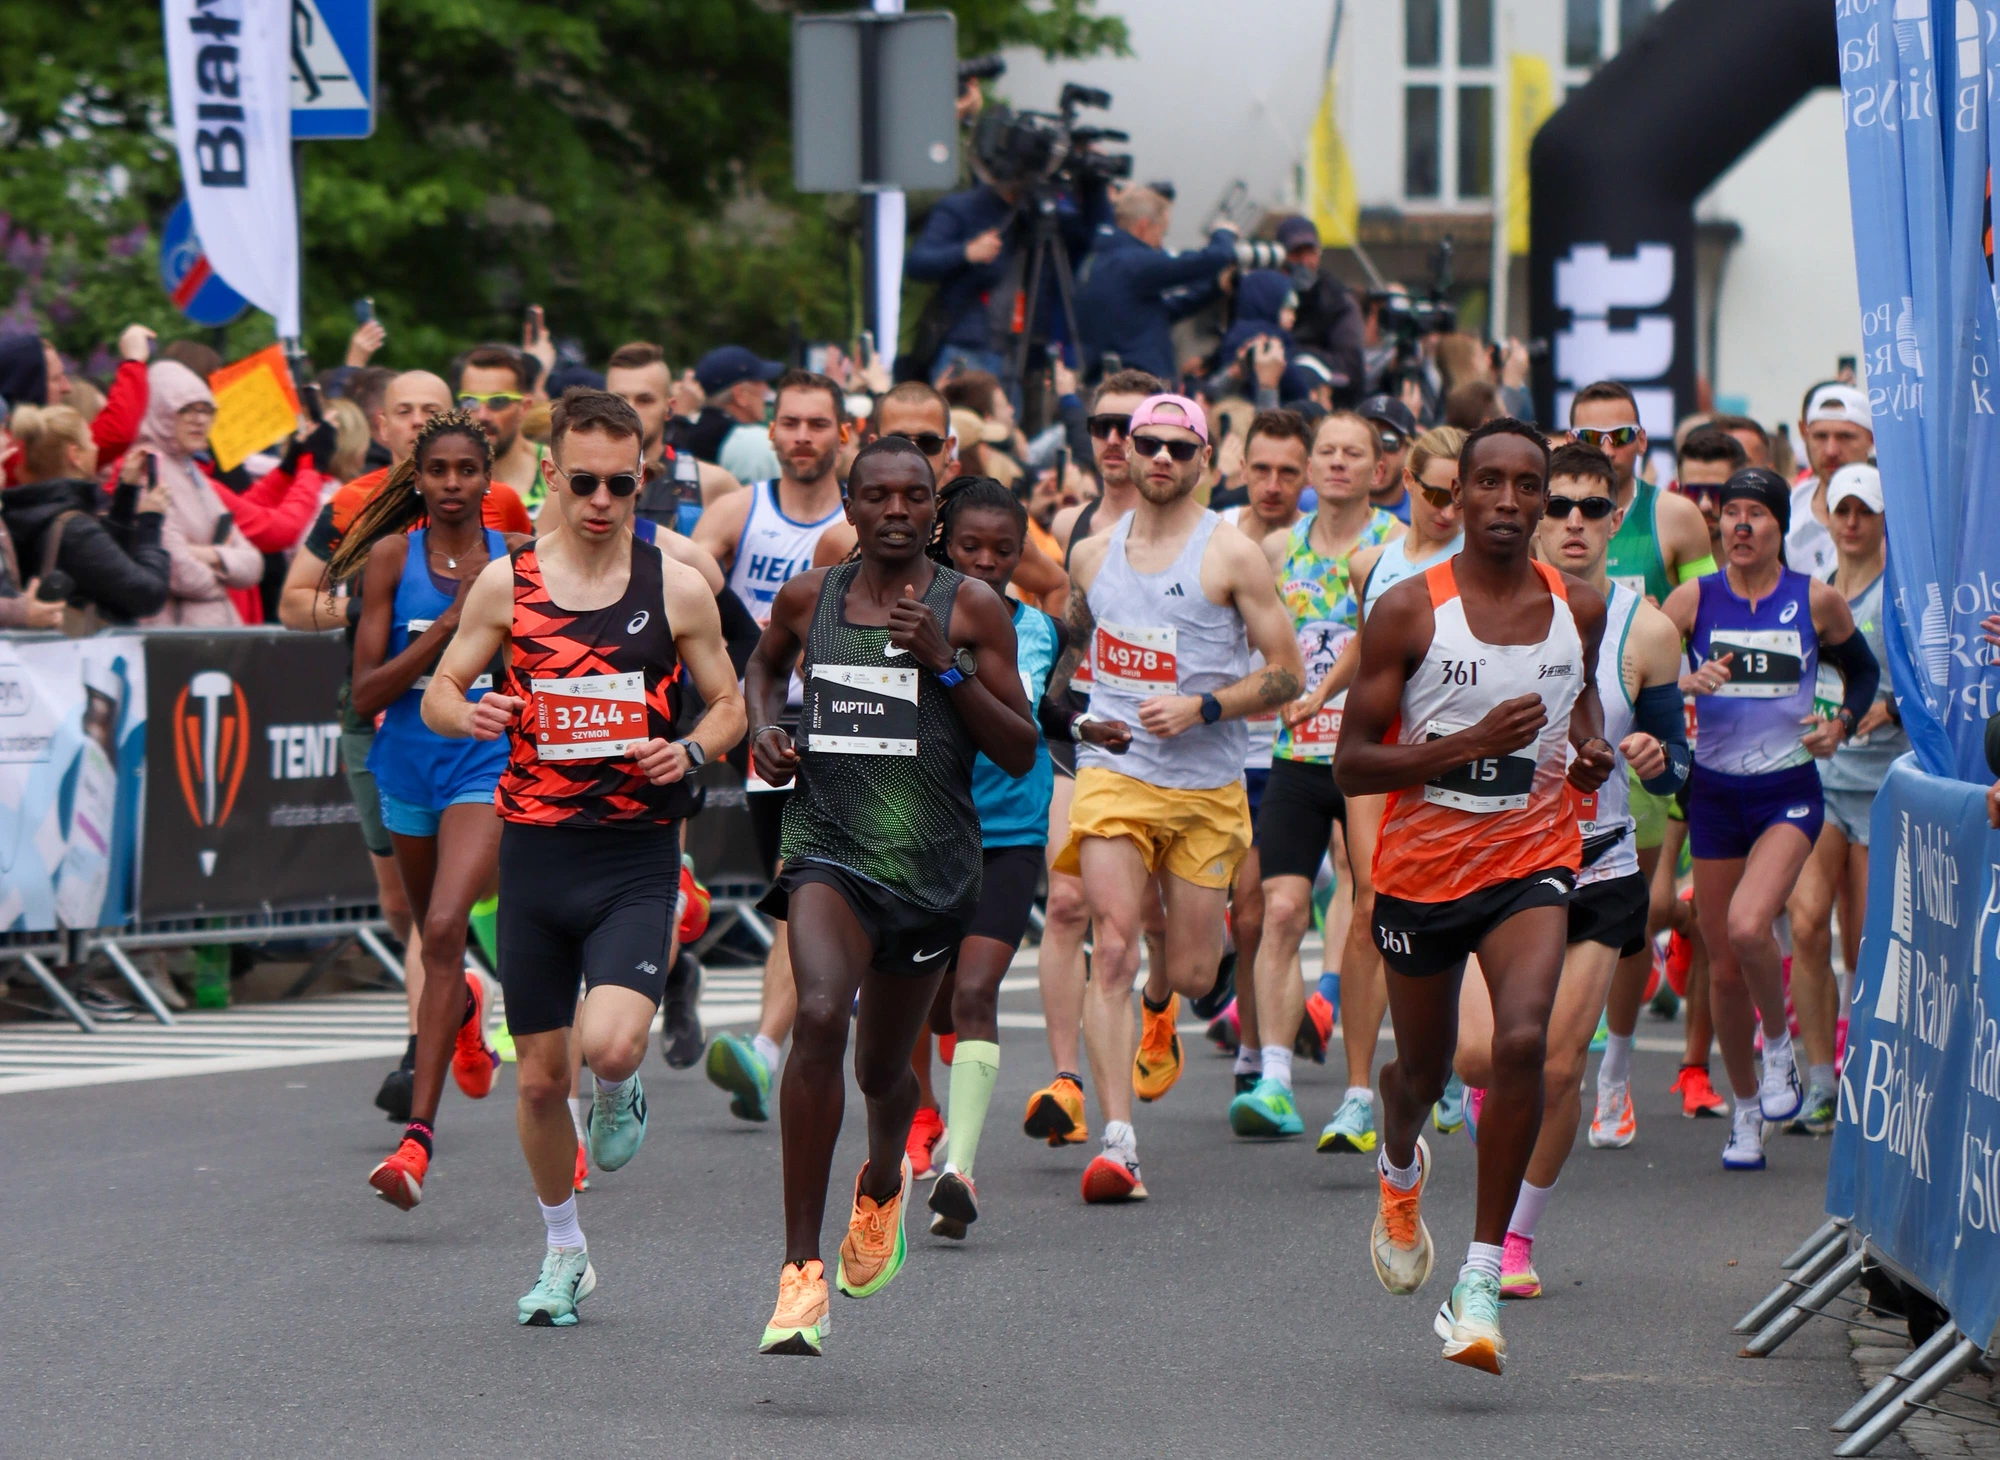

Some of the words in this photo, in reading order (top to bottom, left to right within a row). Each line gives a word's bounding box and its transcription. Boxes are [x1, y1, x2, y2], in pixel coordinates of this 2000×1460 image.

[1107, 645, 1158, 671] 4978
[1742, 653, 1769, 674] 13
[1120, 668, 1142, 678] JAKUB
[555, 703, 625, 730] 3244
[832, 700, 885, 716] KAPTILA
[852, 723, 859, 733] 5
[1306, 712, 1343, 733] 298
[571, 729, 611, 741] SZYMON
[268, 724, 346, 779] TENT
[1467, 757, 1499, 782] 15
